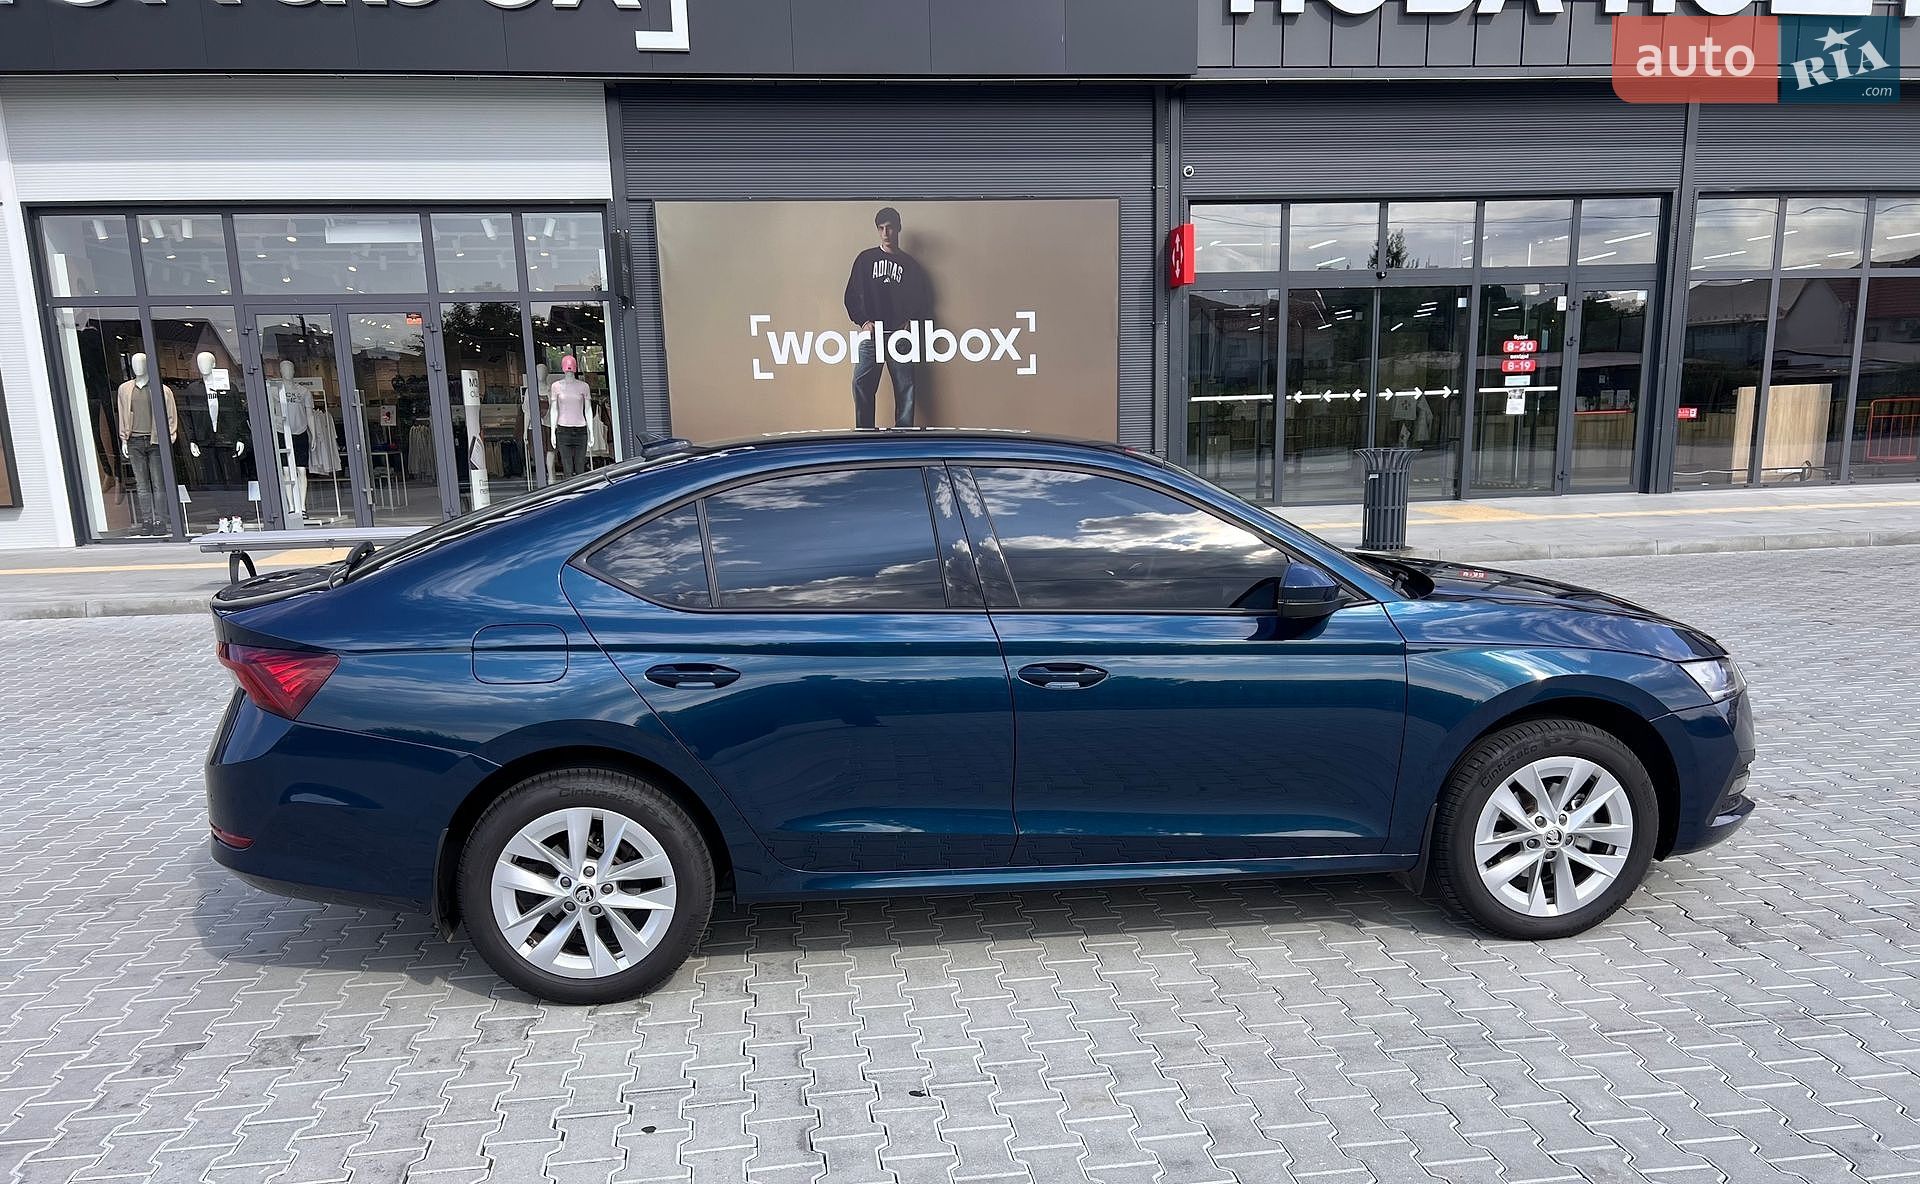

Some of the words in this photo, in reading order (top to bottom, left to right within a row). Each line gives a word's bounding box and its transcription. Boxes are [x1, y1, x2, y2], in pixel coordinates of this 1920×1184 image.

[872, 259, 903, 283] ADIDAS
[766, 319, 1022, 365] worldbox
[1507, 341, 1533, 352] 8-20
[1507, 361, 1531, 371] 8-19
